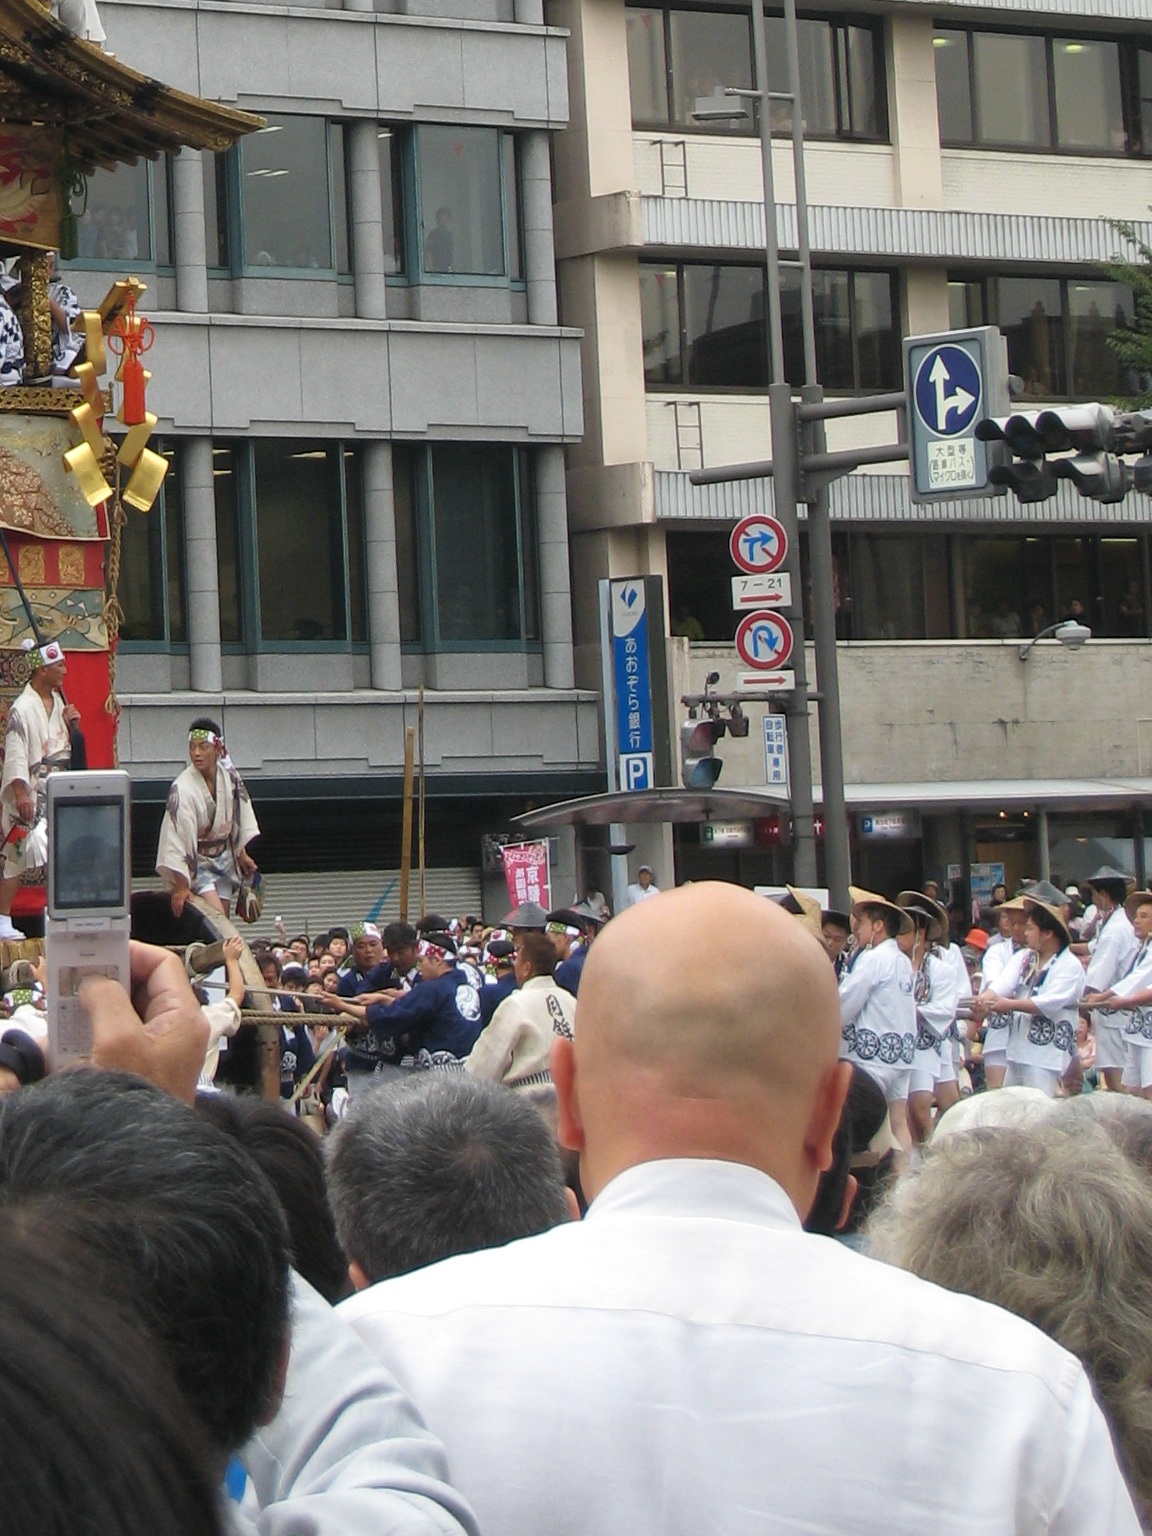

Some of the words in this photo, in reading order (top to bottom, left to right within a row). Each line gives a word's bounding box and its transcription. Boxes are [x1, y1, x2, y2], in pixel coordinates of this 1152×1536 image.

[625, 637, 641, 748] あおぞら銀行
[629, 759, 644, 789] P
